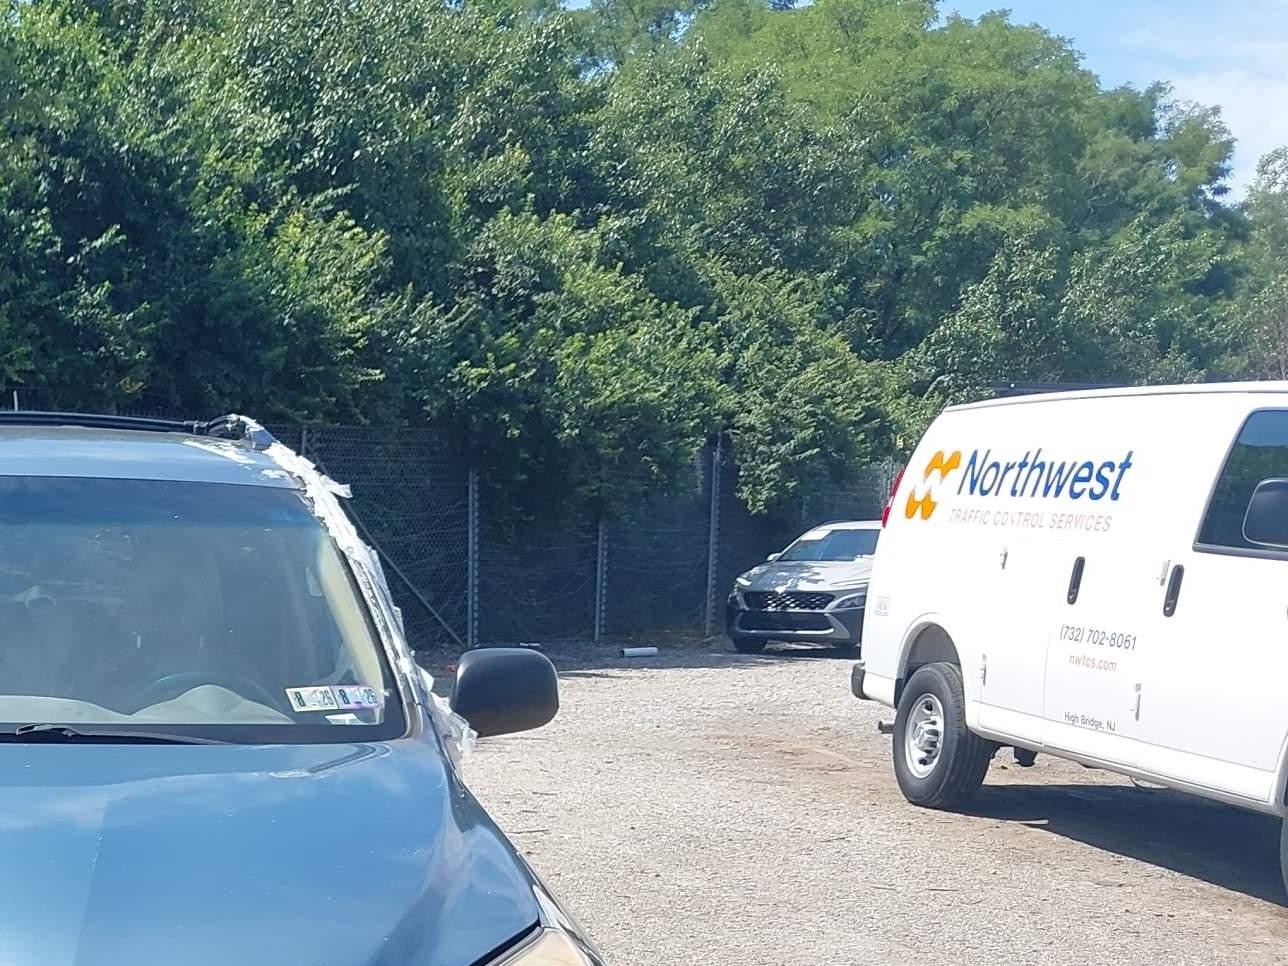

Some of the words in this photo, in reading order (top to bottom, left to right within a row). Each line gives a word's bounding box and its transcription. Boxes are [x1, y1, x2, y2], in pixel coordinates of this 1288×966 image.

[957, 448, 1134, 501] Northwest
[950, 509, 992, 526] TRAFFIC
[1049, 512, 1113, 532] SERVICES
[1060, 624, 1085, 643] (732)
[1086, 629, 1137, 650] 702-8061
[1069, 655, 1117, 672] nwtcs.com
[295, 692, 306, 707] 8
[339, 689, 350, 705] 8
[1064, 712, 1079, 725] High
[1080, 714, 1105, 730] Bridge,
[1106, 720, 1116, 731] NJ
